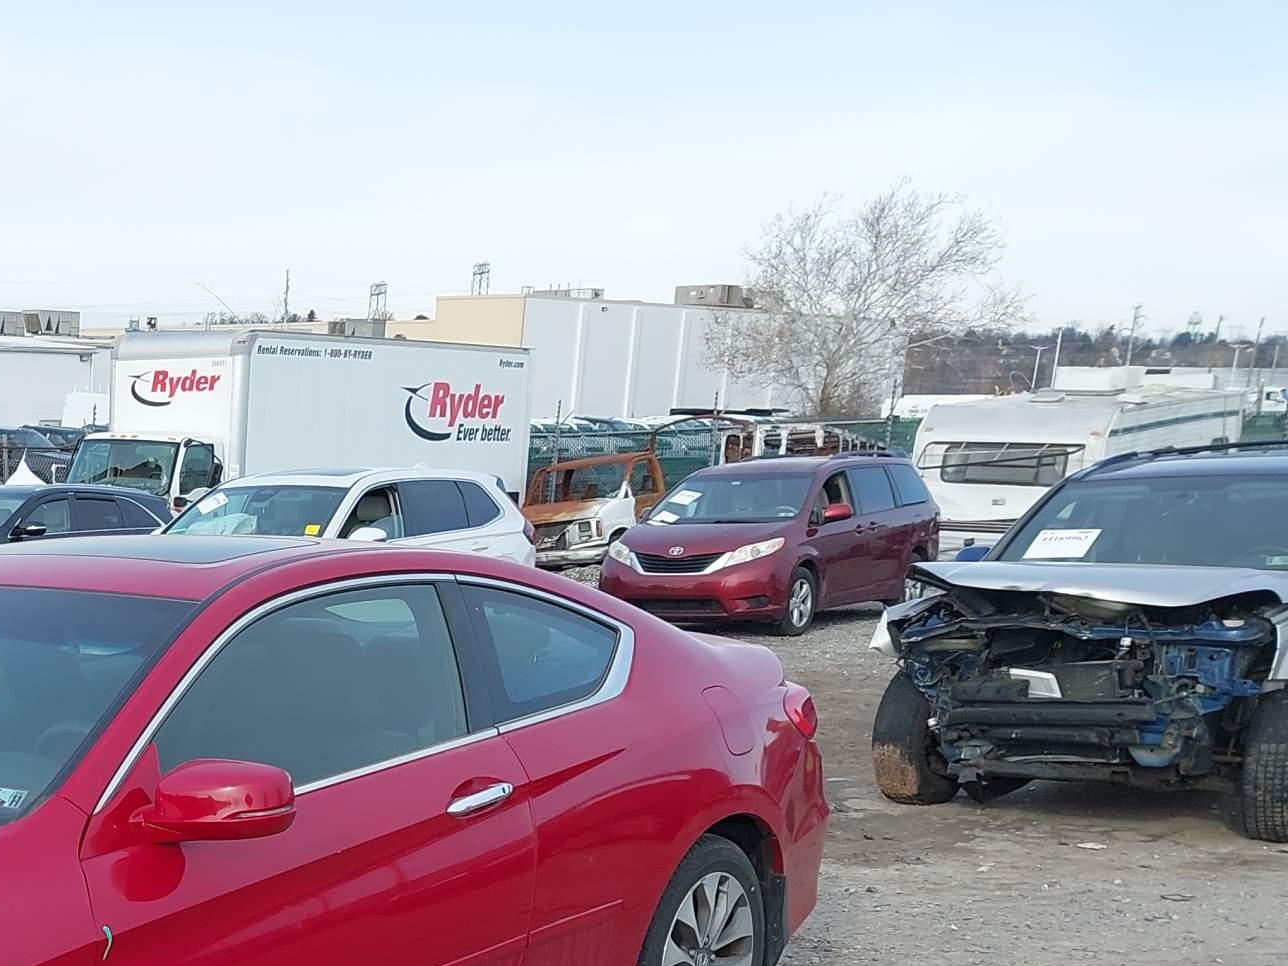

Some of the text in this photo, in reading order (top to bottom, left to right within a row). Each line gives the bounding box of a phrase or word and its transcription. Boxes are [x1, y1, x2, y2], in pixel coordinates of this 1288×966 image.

[257, 344, 278, 355] Rental
[279, 345, 322, 358] Reservations:
[498, 358, 525, 369] Ryder.com
[150, 369, 221, 398] Ryder
[428, 382, 505, 428] Ryder
[455, 423, 512, 442] Ever better.
